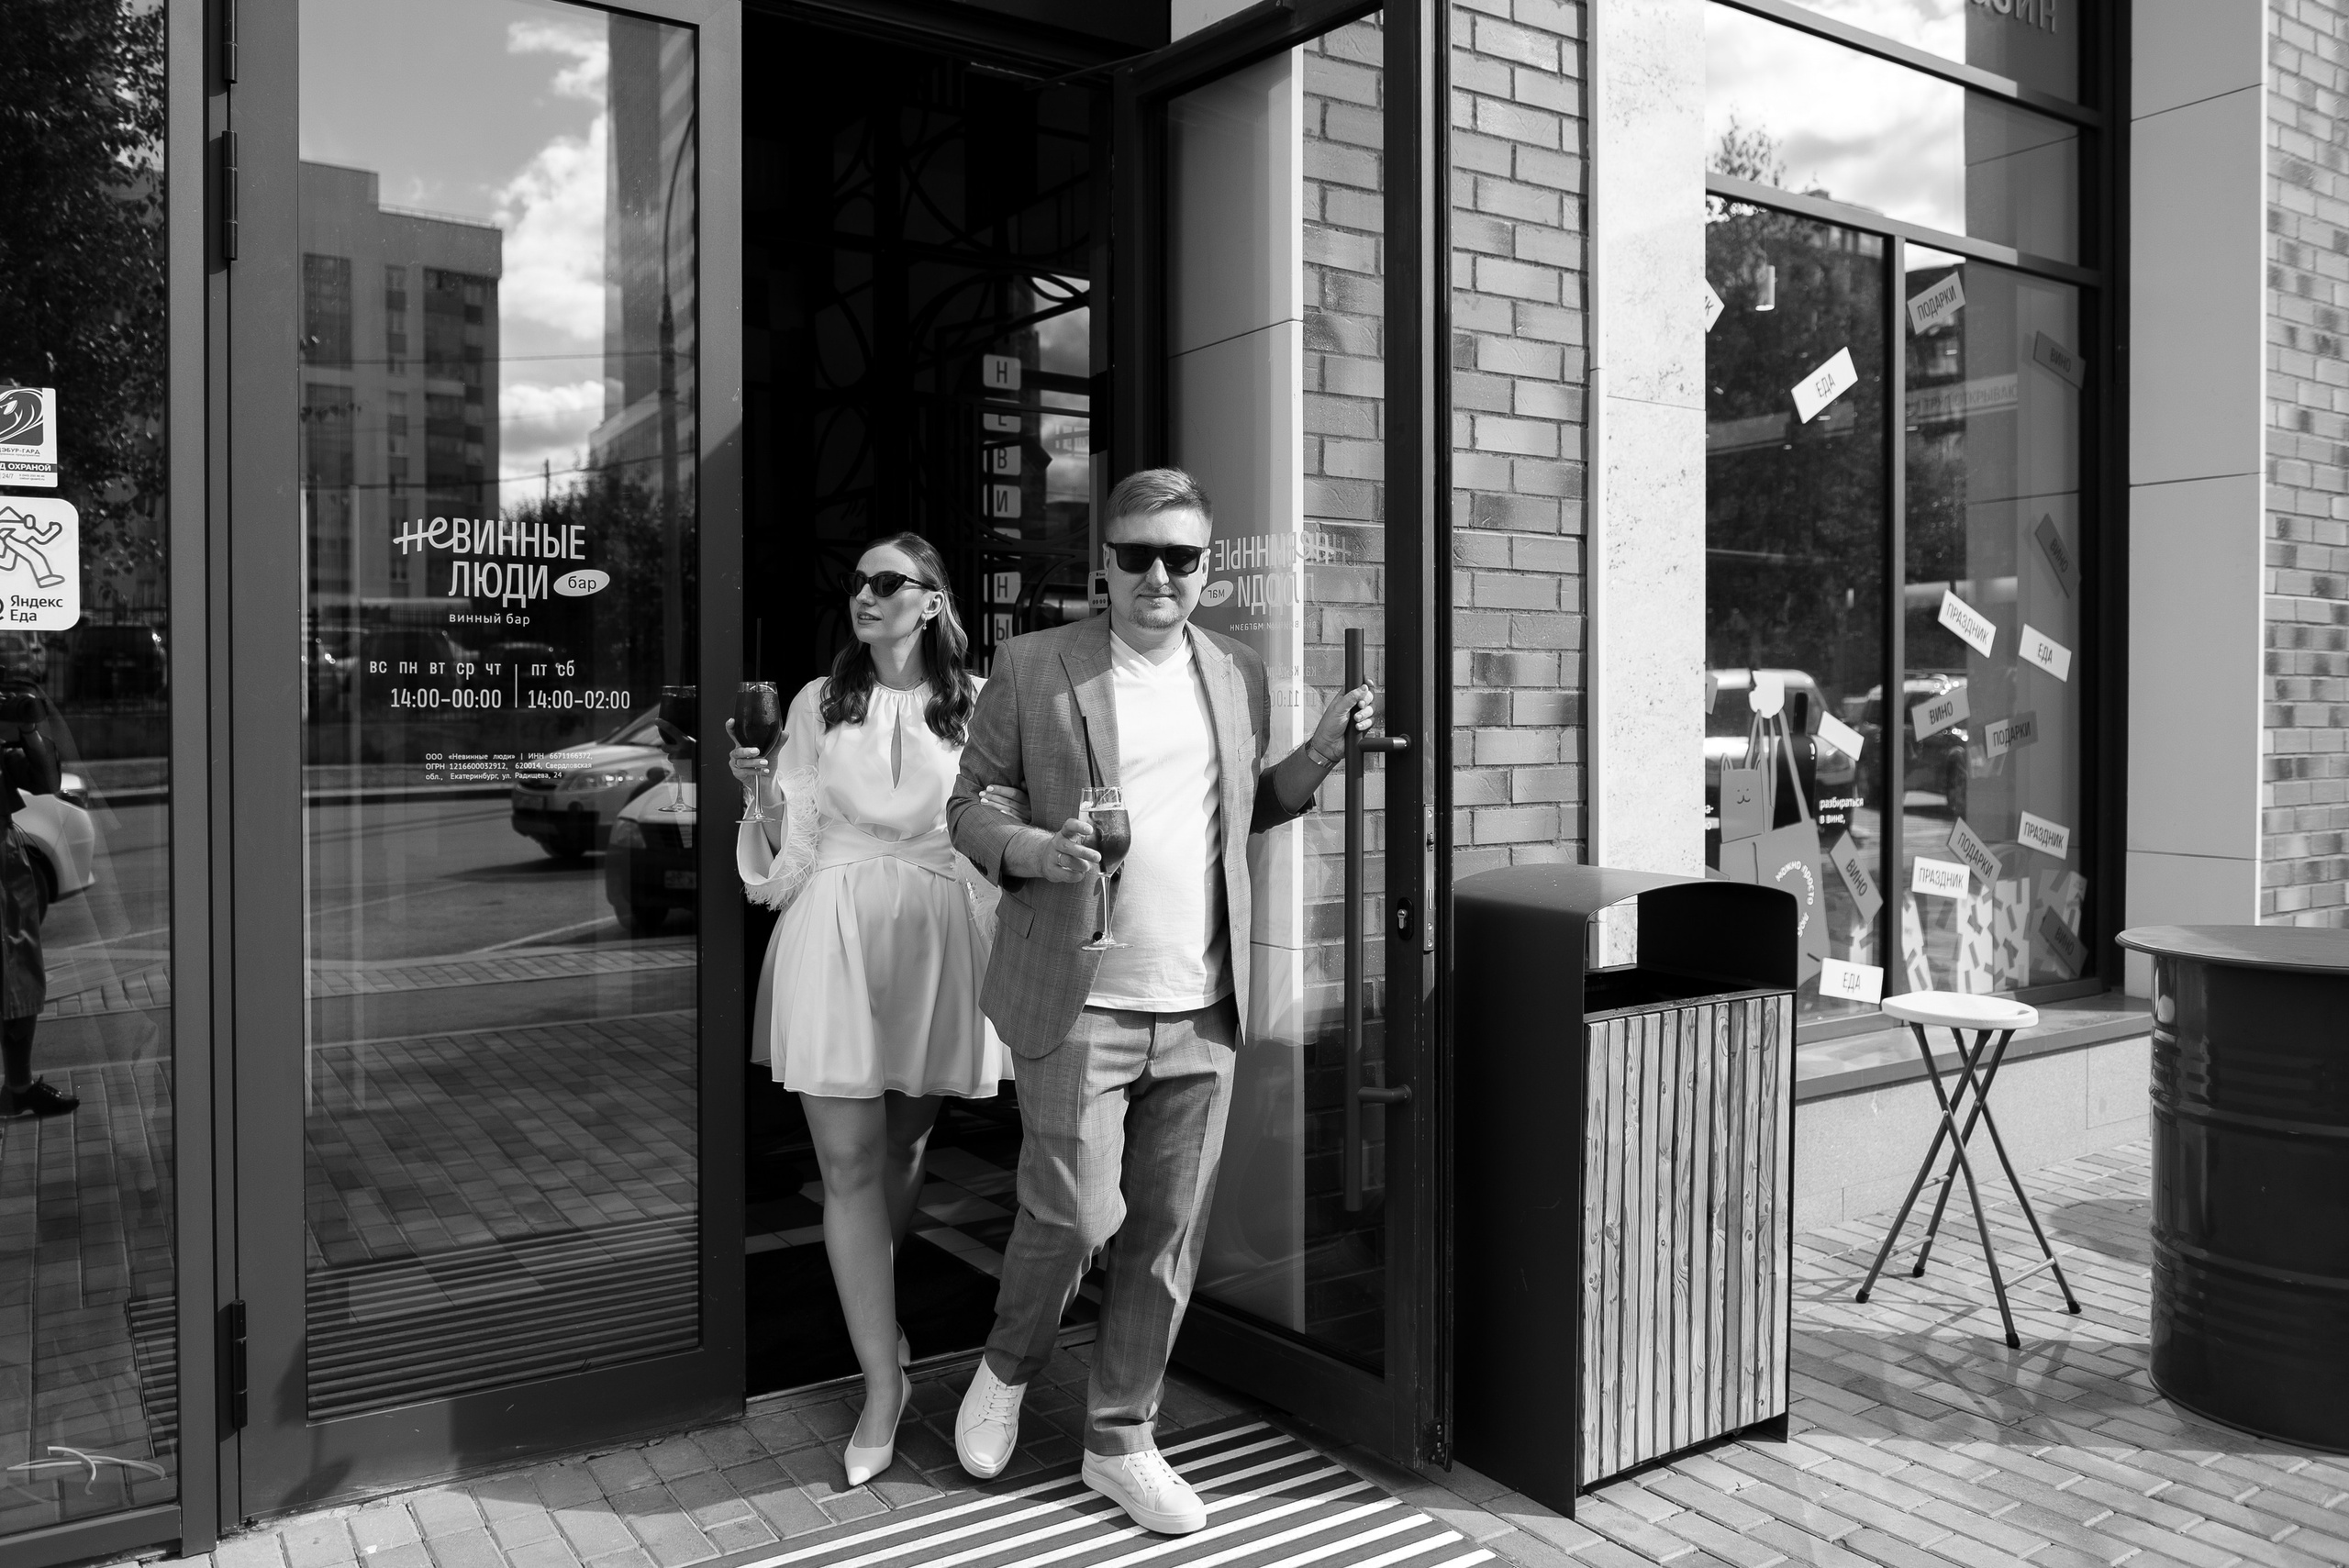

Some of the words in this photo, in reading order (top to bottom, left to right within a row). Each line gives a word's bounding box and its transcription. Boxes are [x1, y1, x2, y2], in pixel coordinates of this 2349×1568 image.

[1917, 284, 1957, 321] ПОДАРКИ
[2049, 346, 2072, 373] ВИНО
[1815, 373, 1836, 399] ЕДА
[0, 447, 40, 455] ЭБУР-ГАРД
[8, 463, 51, 472] ОХРАНОЙ
[2049, 538, 2069, 573] ВИНО
[448, 561, 549, 608] ЛЮДИ
[567, 575, 597, 593] бар
[10, 595, 63, 609] Яндекс
[10, 610, 38, 622] Еда
[449, 612, 502, 625] винный
[506, 613, 530, 627] бар
[1946, 602, 1989, 645] ПРАЗДНИК
[2037, 643, 2054, 664] ЕДА
[370, 662, 387, 673] вс
[399, 662, 417, 674] пн
[429, 662, 446, 674] вт
[456, 662, 475, 680] ср
[485, 662, 502, 675] чт
[531, 663, 548, 676] пт
[557, 660, 575, 676] сб
[1929, 701, 1954, 725] ВИНО
[1993, 721, 2032, 747] ПОДАРКИ
[450, 773, 499, 781] Екатеринбург,
[515, 772, 551, 780] Радищева,
[1819, 796, 1864, 811] разбираться
[1819, 815, 1825, 823] в
[1826, 814, 1846, 824] вине,
[2024, 822, 2065, 850] ПРАЗДНИК
[1957, 832, 1994, 878] ПОДАРКИ
[1845, 859, 1868, 896] ВИНО
[1919, 867, 1965, 889] ПРАЗДНИК
[2054, 927, 2076, 956] ВИНО
[1842, 973, 1861, 992] ЕДА
